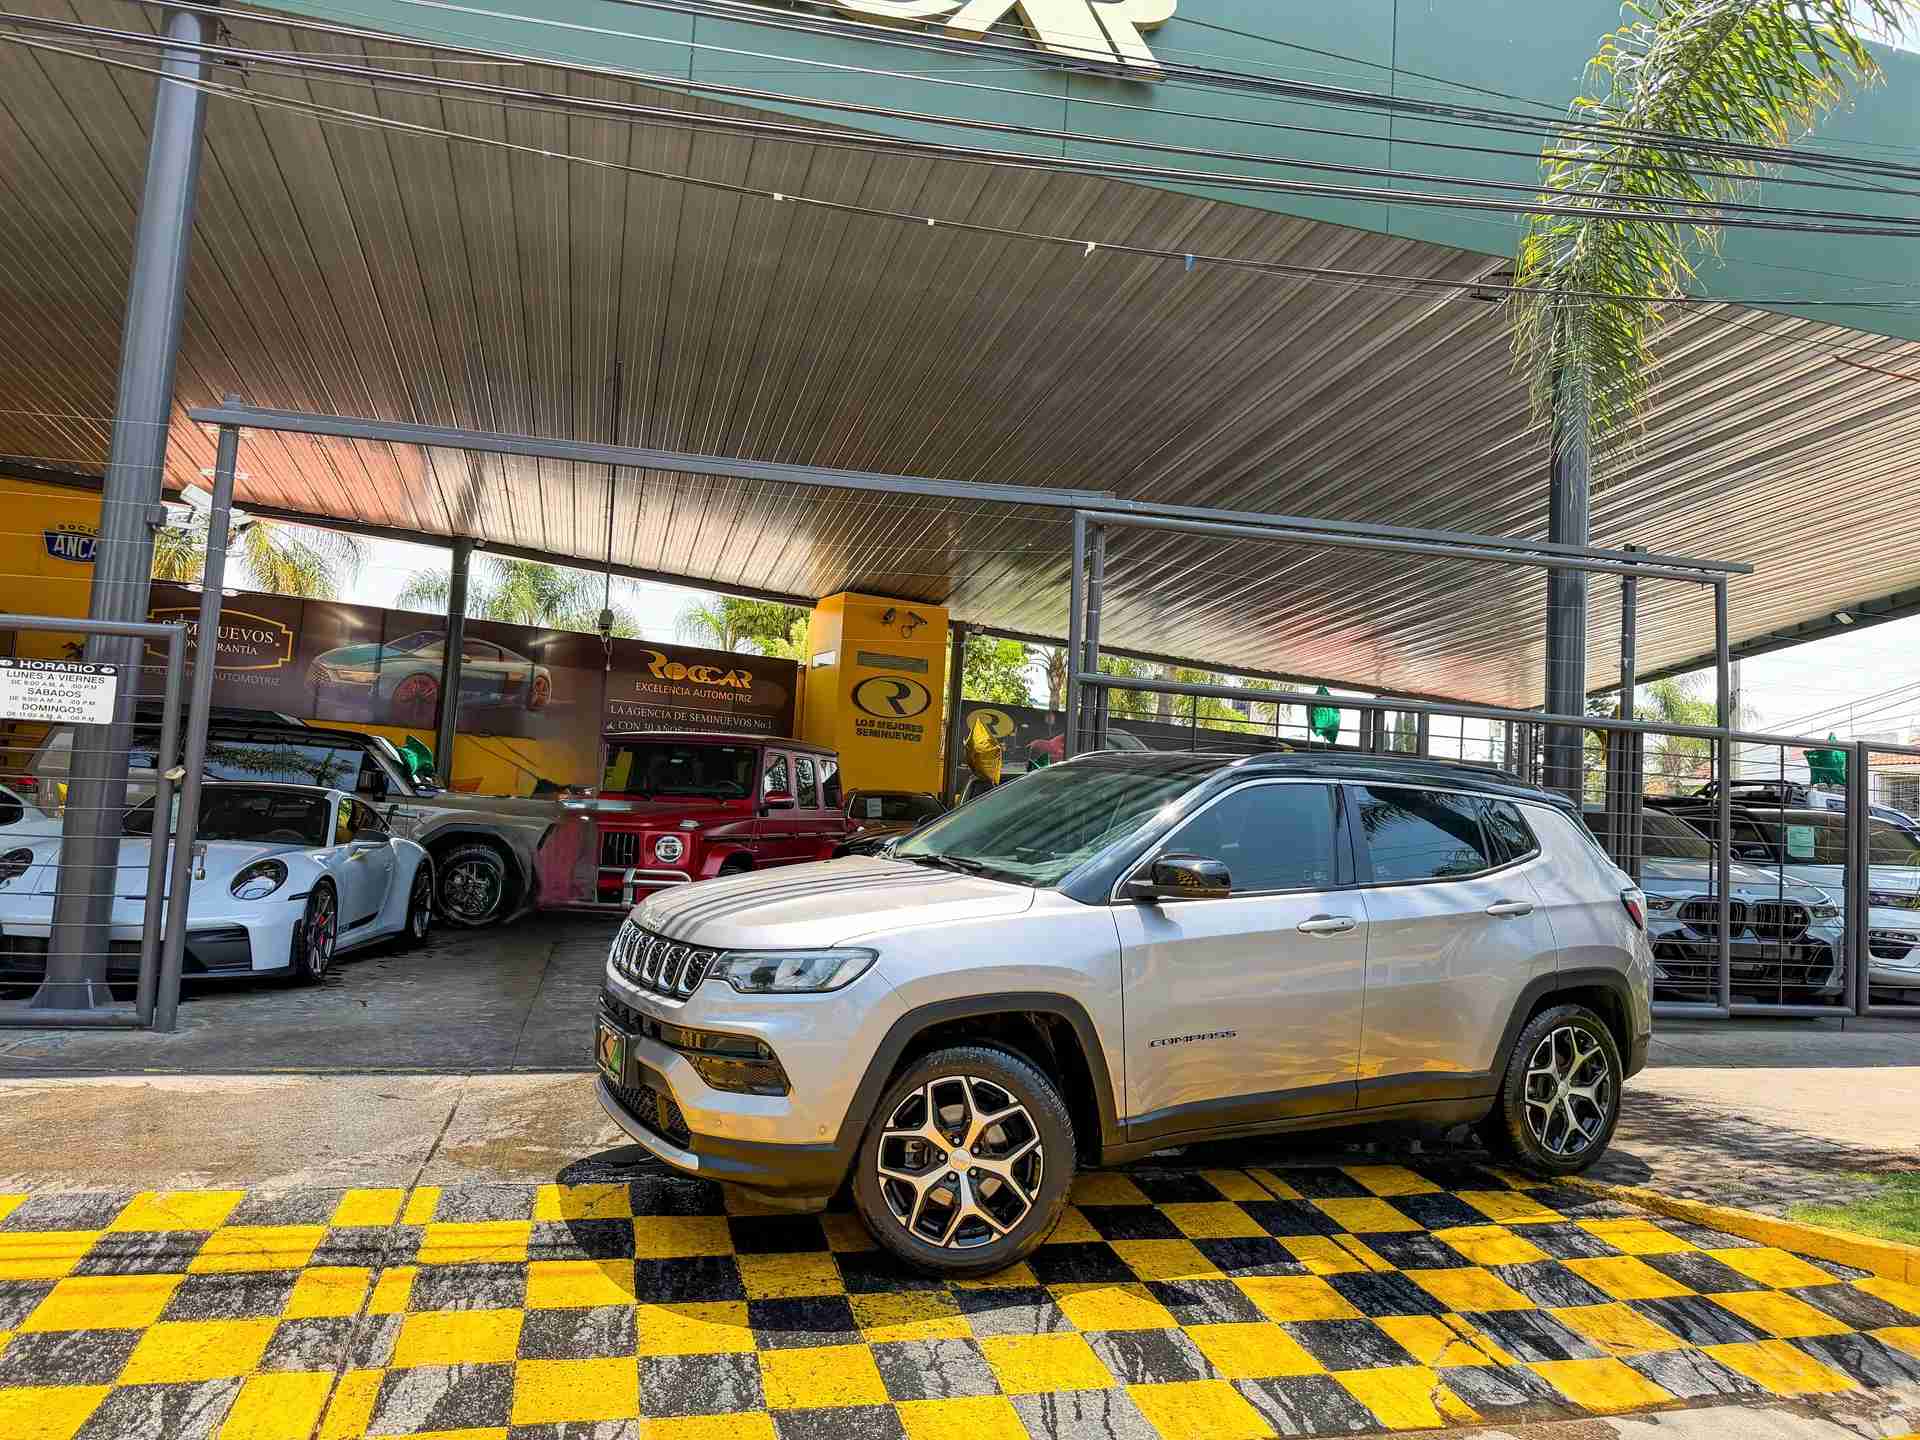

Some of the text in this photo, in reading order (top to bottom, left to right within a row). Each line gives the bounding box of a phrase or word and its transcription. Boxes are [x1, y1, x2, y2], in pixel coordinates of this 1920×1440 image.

[20, 660, 96, 673] HORARIO
[640, 648, 753, 689] ROCCAR
[7, 670, 45, 680] LUNES
[59, 674, 105, 685] VIERNES
[635, 680, 753, 703] EXCELENCIA AUTOMOTRIZ
[22, 703, 84, 714] DOMINGOS
[610, 703, 625, 715] LA
[625, 705, 672, 720] AGENCIA
[674, 711, 688, 721] DE
[689, 712, 752, 728] SEMINUEVOS
[855, 718, 924, 733] LOS MEJORES
[855, 727, 921, 742] SEMINUEVOS
[1149, 1030, 1238, 1048] COMPASS
